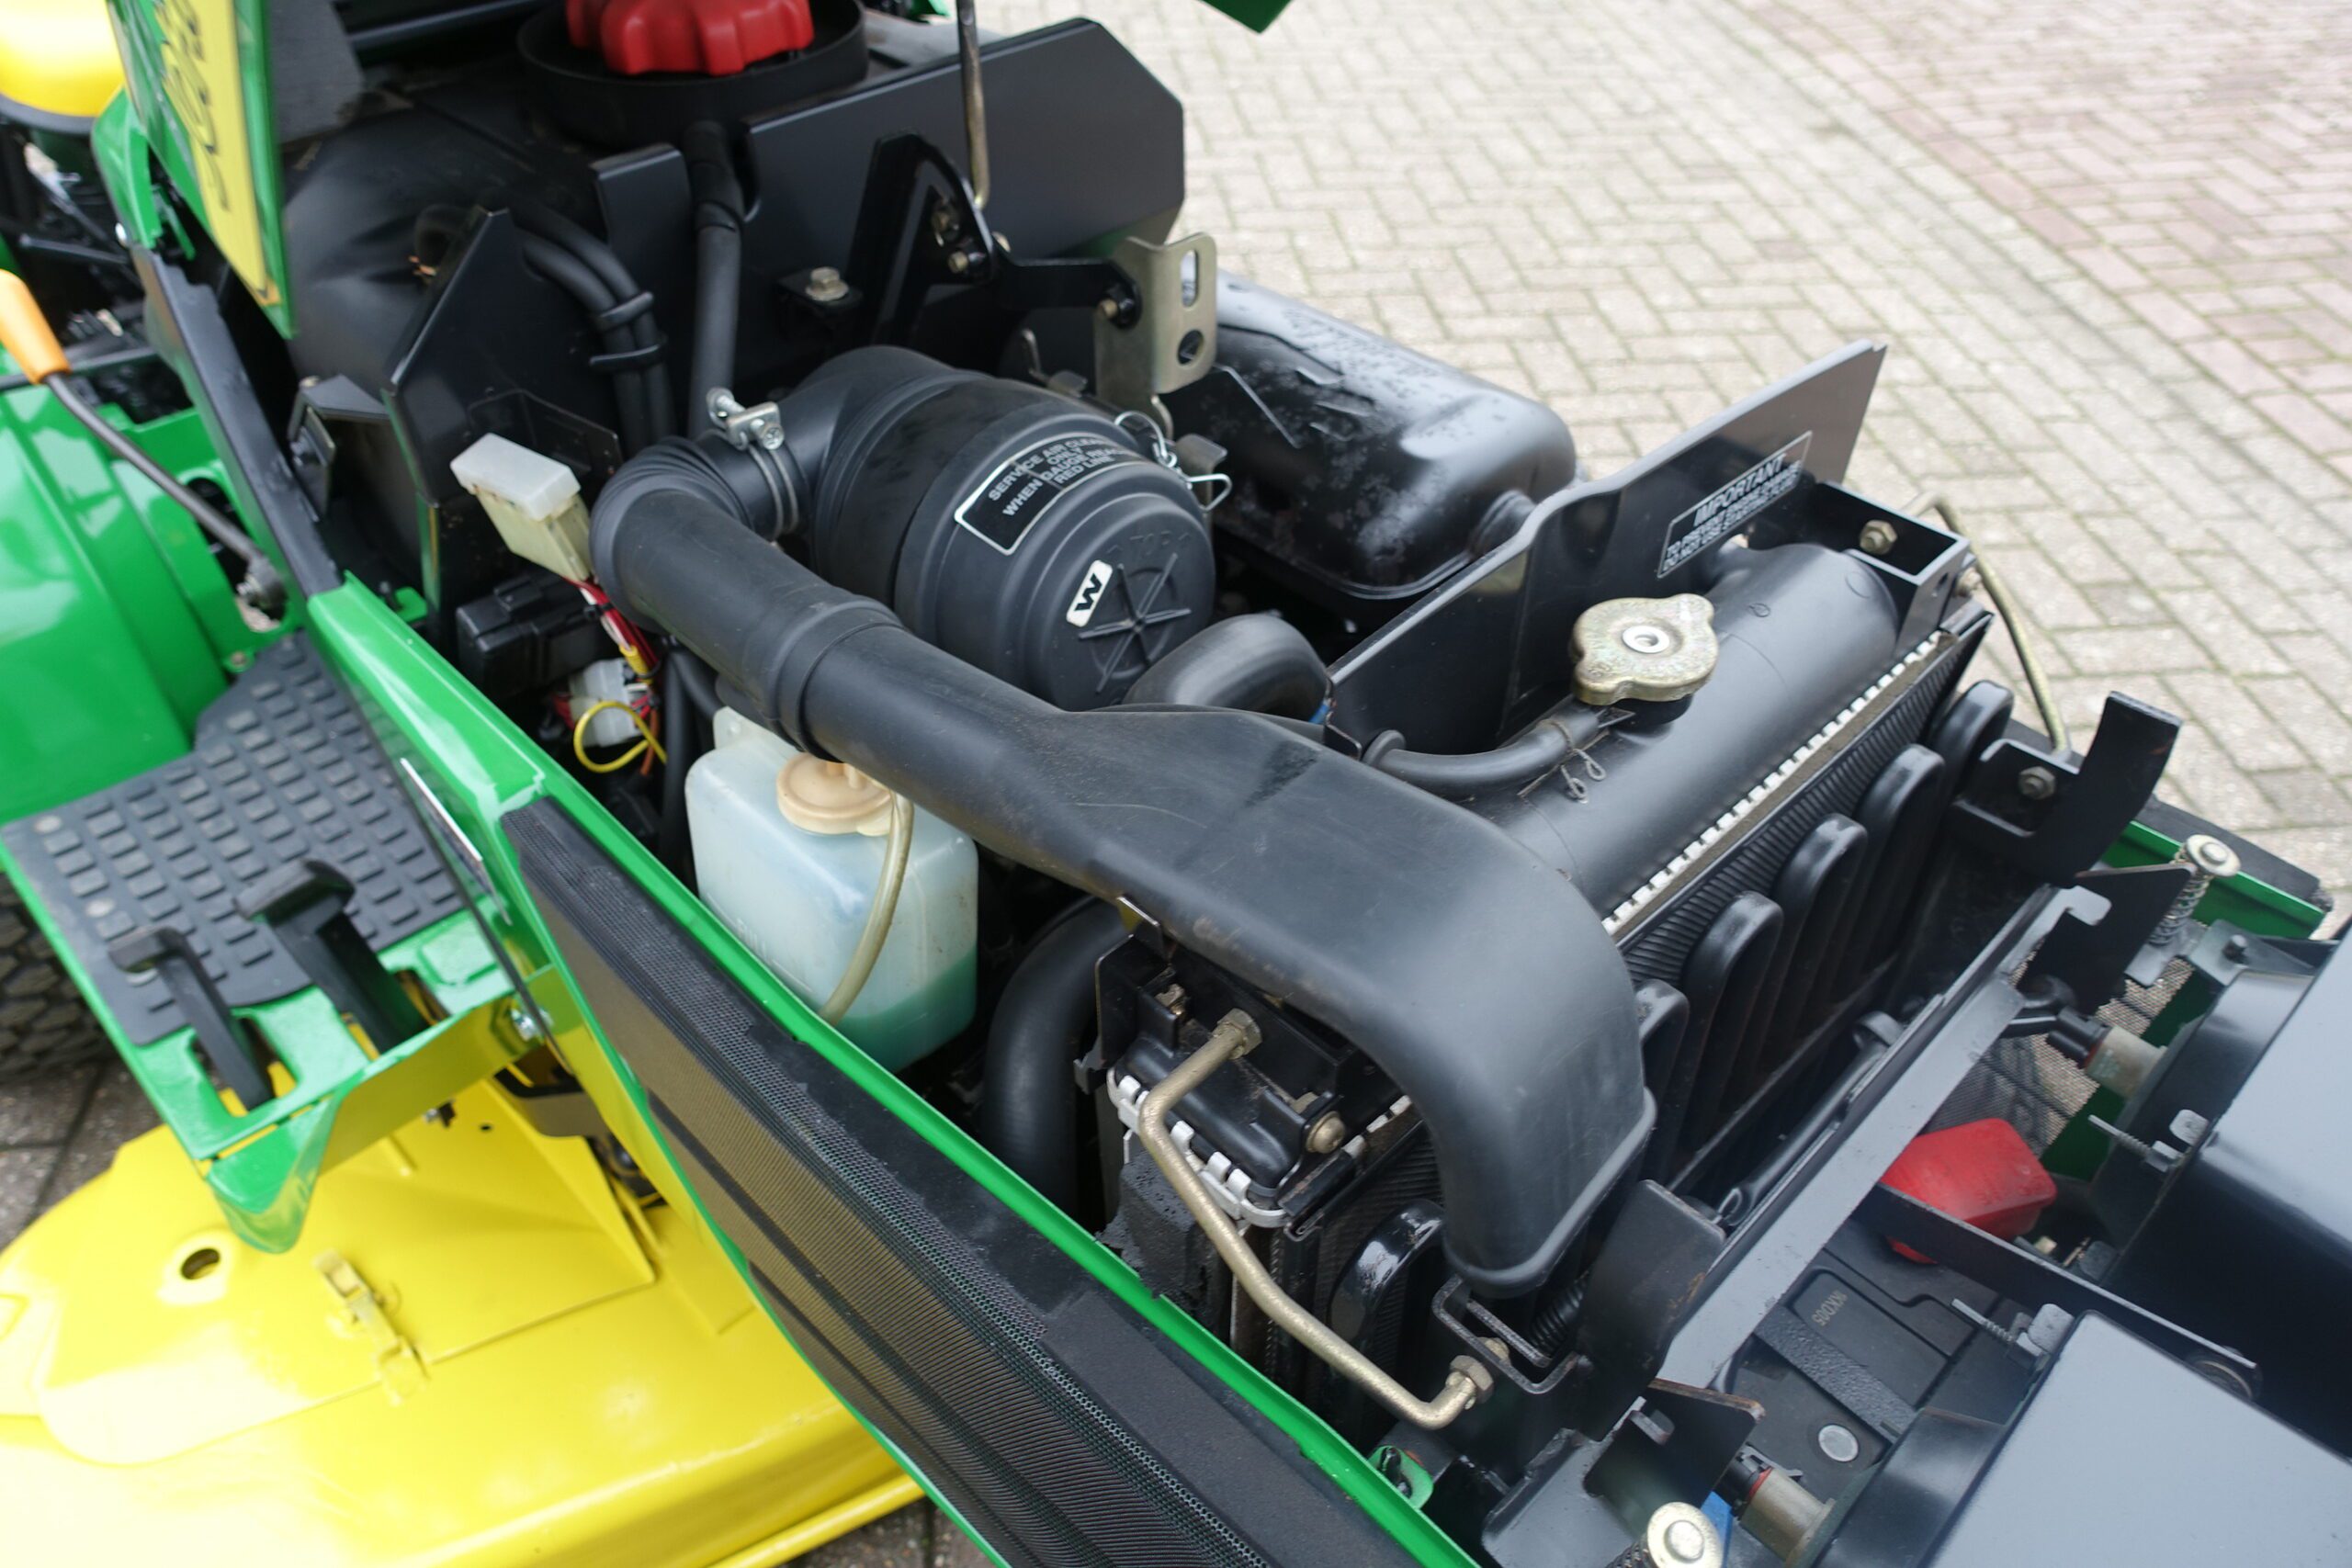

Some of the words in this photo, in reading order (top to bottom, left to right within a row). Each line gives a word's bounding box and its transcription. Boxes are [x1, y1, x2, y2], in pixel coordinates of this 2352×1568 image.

[988, 454, 1044, 502] SERVICE
[1041, 443, 1068, 458] AIR
[1046, 446, 1084, 466] ONLY
[1053, 465, 1085, 484] RED
[1082, 456, 1115, 468] LINE
[1001, 477, 1044, 517] WHEN
[1040, 453, 1090, 482] GAUGE
[1693, 453, 1787, 527] IMPORTANT
[1073, 572, 1103, 612] W
